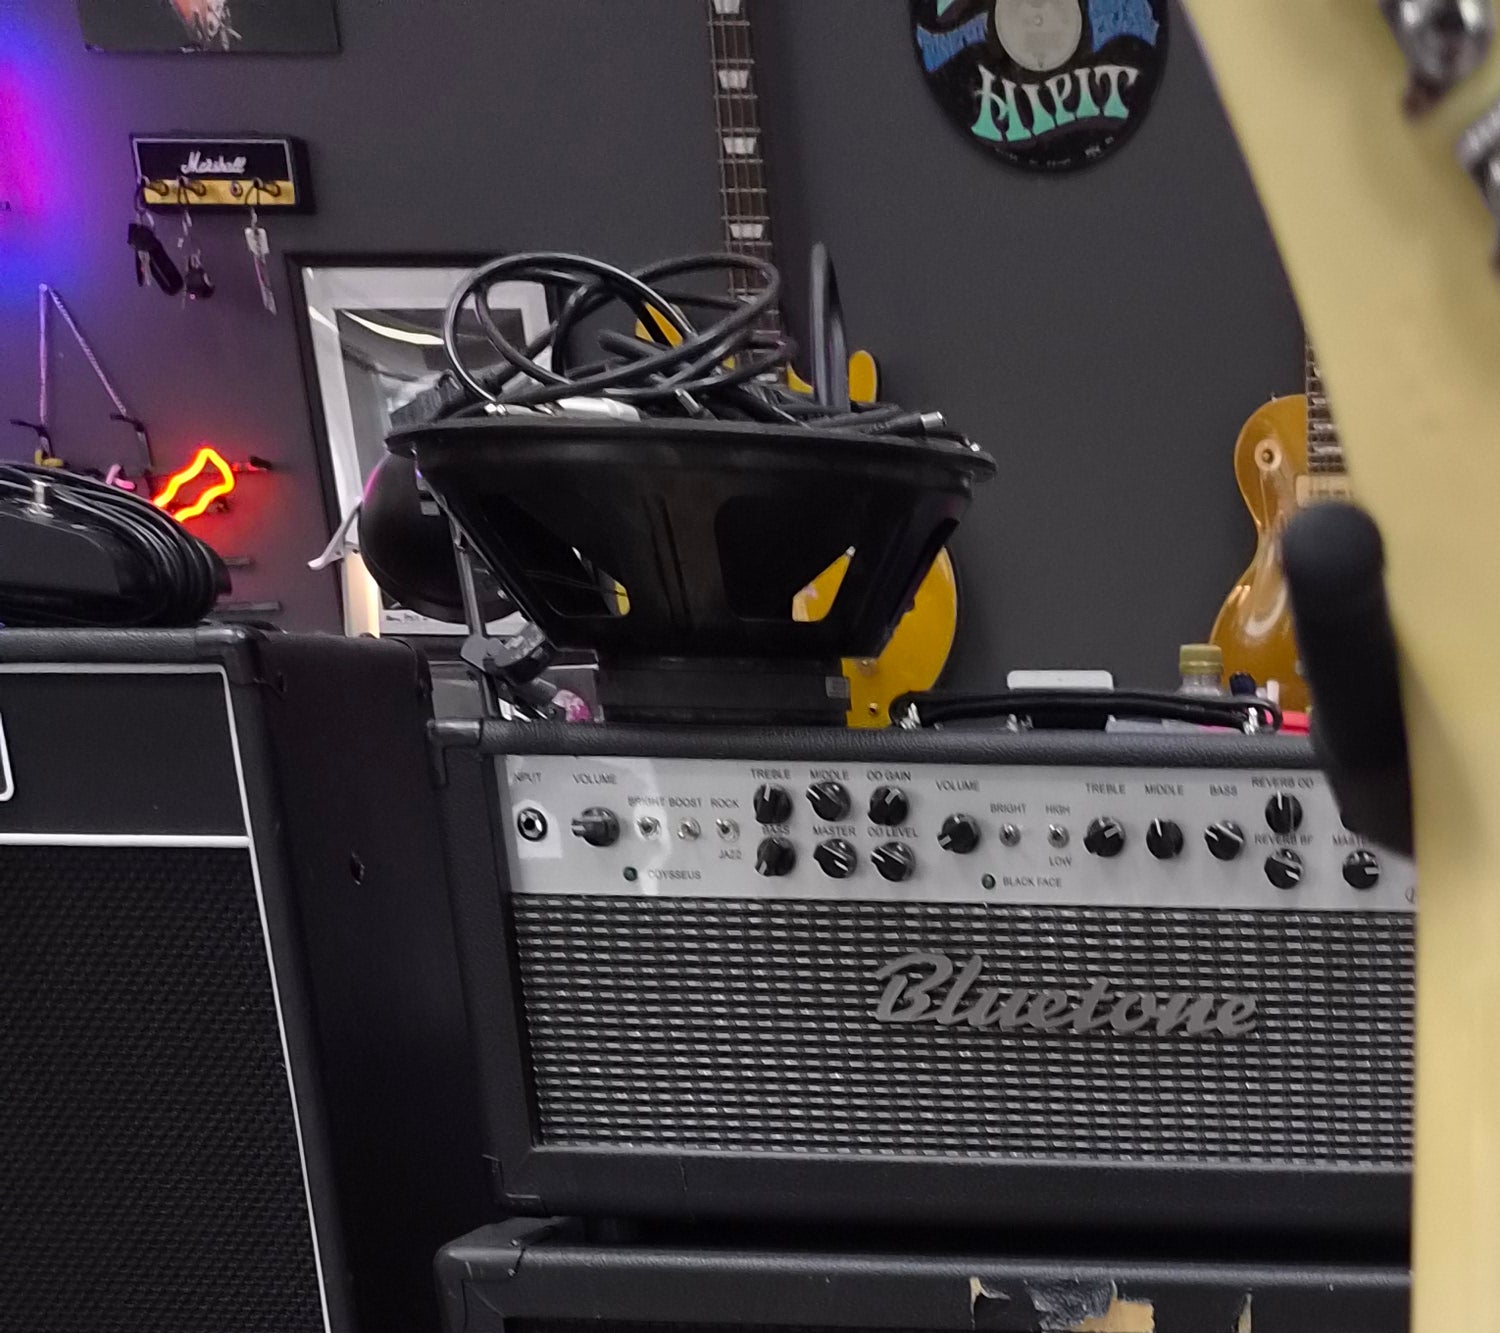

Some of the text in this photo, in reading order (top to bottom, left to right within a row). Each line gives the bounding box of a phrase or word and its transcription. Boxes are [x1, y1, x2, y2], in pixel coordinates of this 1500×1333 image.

[180, 151, 247, 174] Marshall
[573, 773, 617, 785] VOLUME
[750, 769, 791, 780] TREBLE
[809, 769, 850, 781] MIDDLE
[884, 770, 911, 782] GAIN
[936, 780, 980, 792] VOLUME
[1085, 782, 1126, 795] TREBLE
[1251, 777, 1295, 788] REVERB
[1145, 783, 1184, 796] MIDDLE
[1209, 784, 1238, 797] BASS
[668, 797, 702, 808] BOOST
[711, 798, 740, 808] ROCK
[990, 803, 1027, 815] BRIGHT
[1045, 804, 1071, 815] HIGH
[813, 826, 857, 837] MASTER
[883, 827, 919, 838] LEVEL
[1049, 856, 1073, 867] LOW
[1003, 877, 1034, 888] BLACK
[874, 951, 1258, 1038] Bluetone
